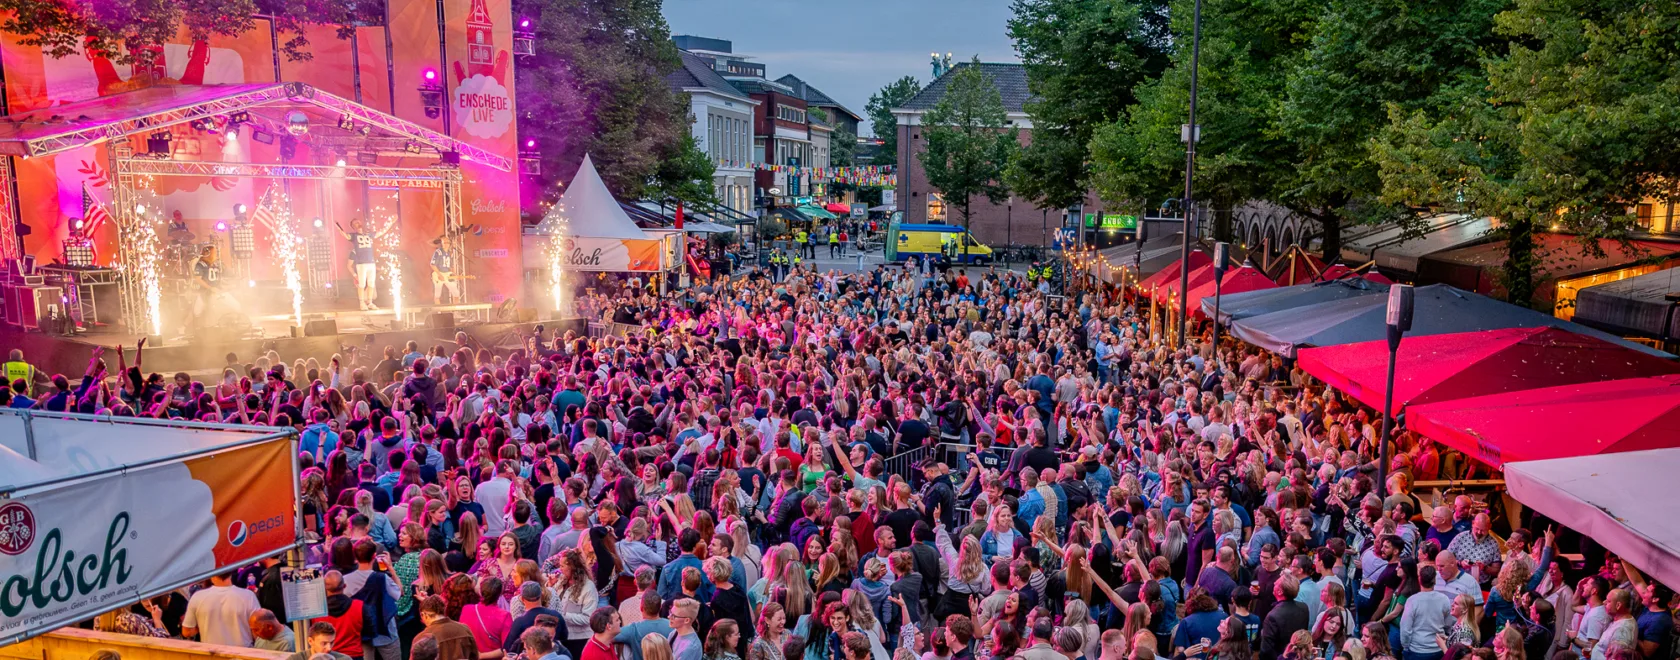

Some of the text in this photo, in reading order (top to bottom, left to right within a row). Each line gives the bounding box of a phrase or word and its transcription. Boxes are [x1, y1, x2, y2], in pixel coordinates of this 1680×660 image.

[460, 93, 508, 111] ENSCHEDE
[473, 108, 494, 123] LIVE
[470, 198, 505, 215] Grolsch
[483, 226, 505, 235] pepsi
[1054, 229, 1076, 242] WC
[357, 235, 372, 248] 99
[564, 247, 602, 266] olsch
[984, 456, 998, 465] CREW
[249, 511, 284, 539] pepsi
[0, 511, 133, 618] olsch
[70, 600, 88, 610] Geen
